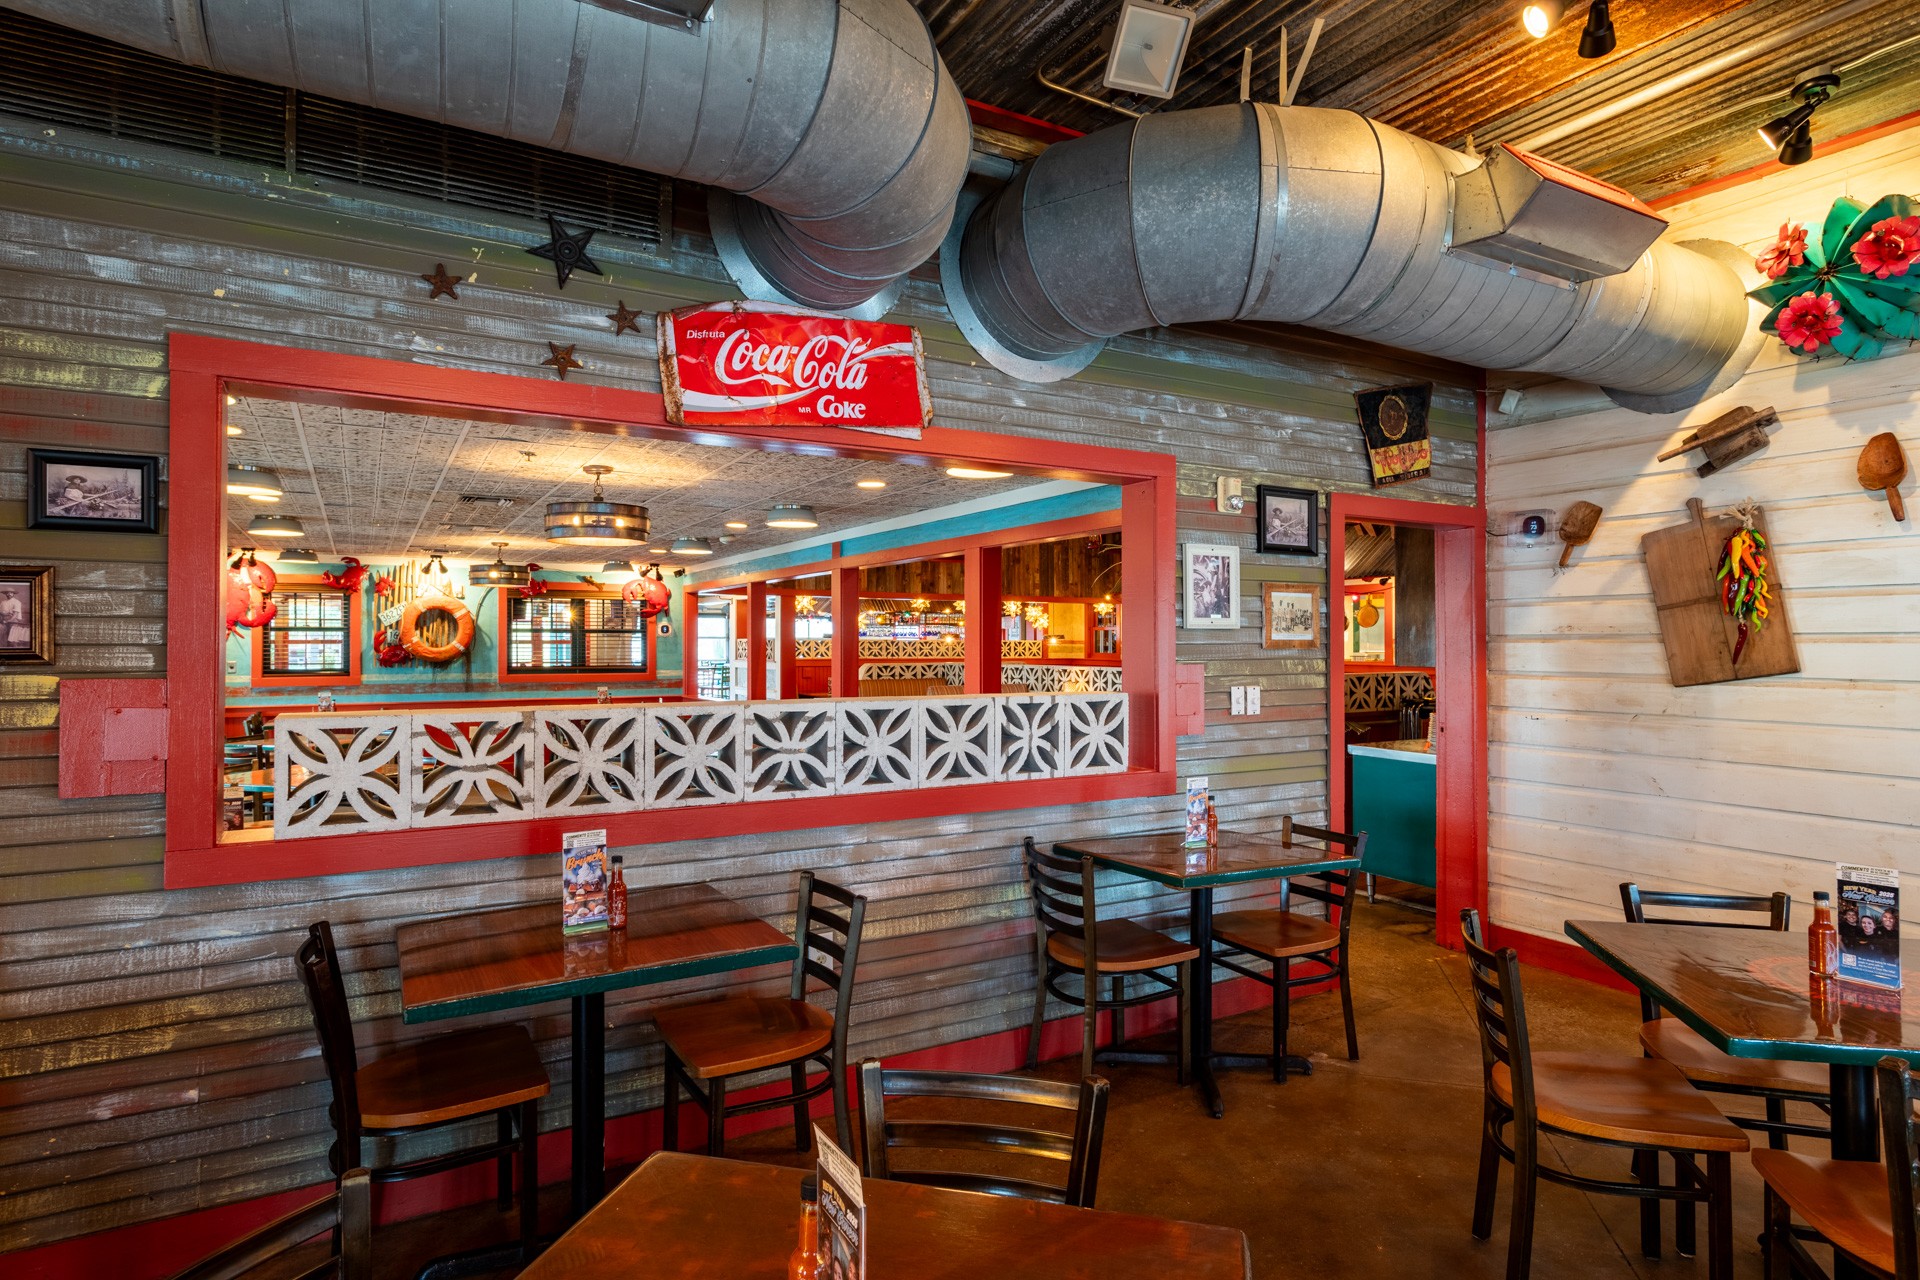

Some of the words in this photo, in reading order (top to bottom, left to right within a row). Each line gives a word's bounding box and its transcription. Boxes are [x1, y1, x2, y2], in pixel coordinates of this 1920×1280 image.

[686, 329, 726, 340] Disfruta
[714, 328, 872, 390] Coca-Cola
[798, 406, 812, 414] MR
[816, 394, 867, 420] Coke
